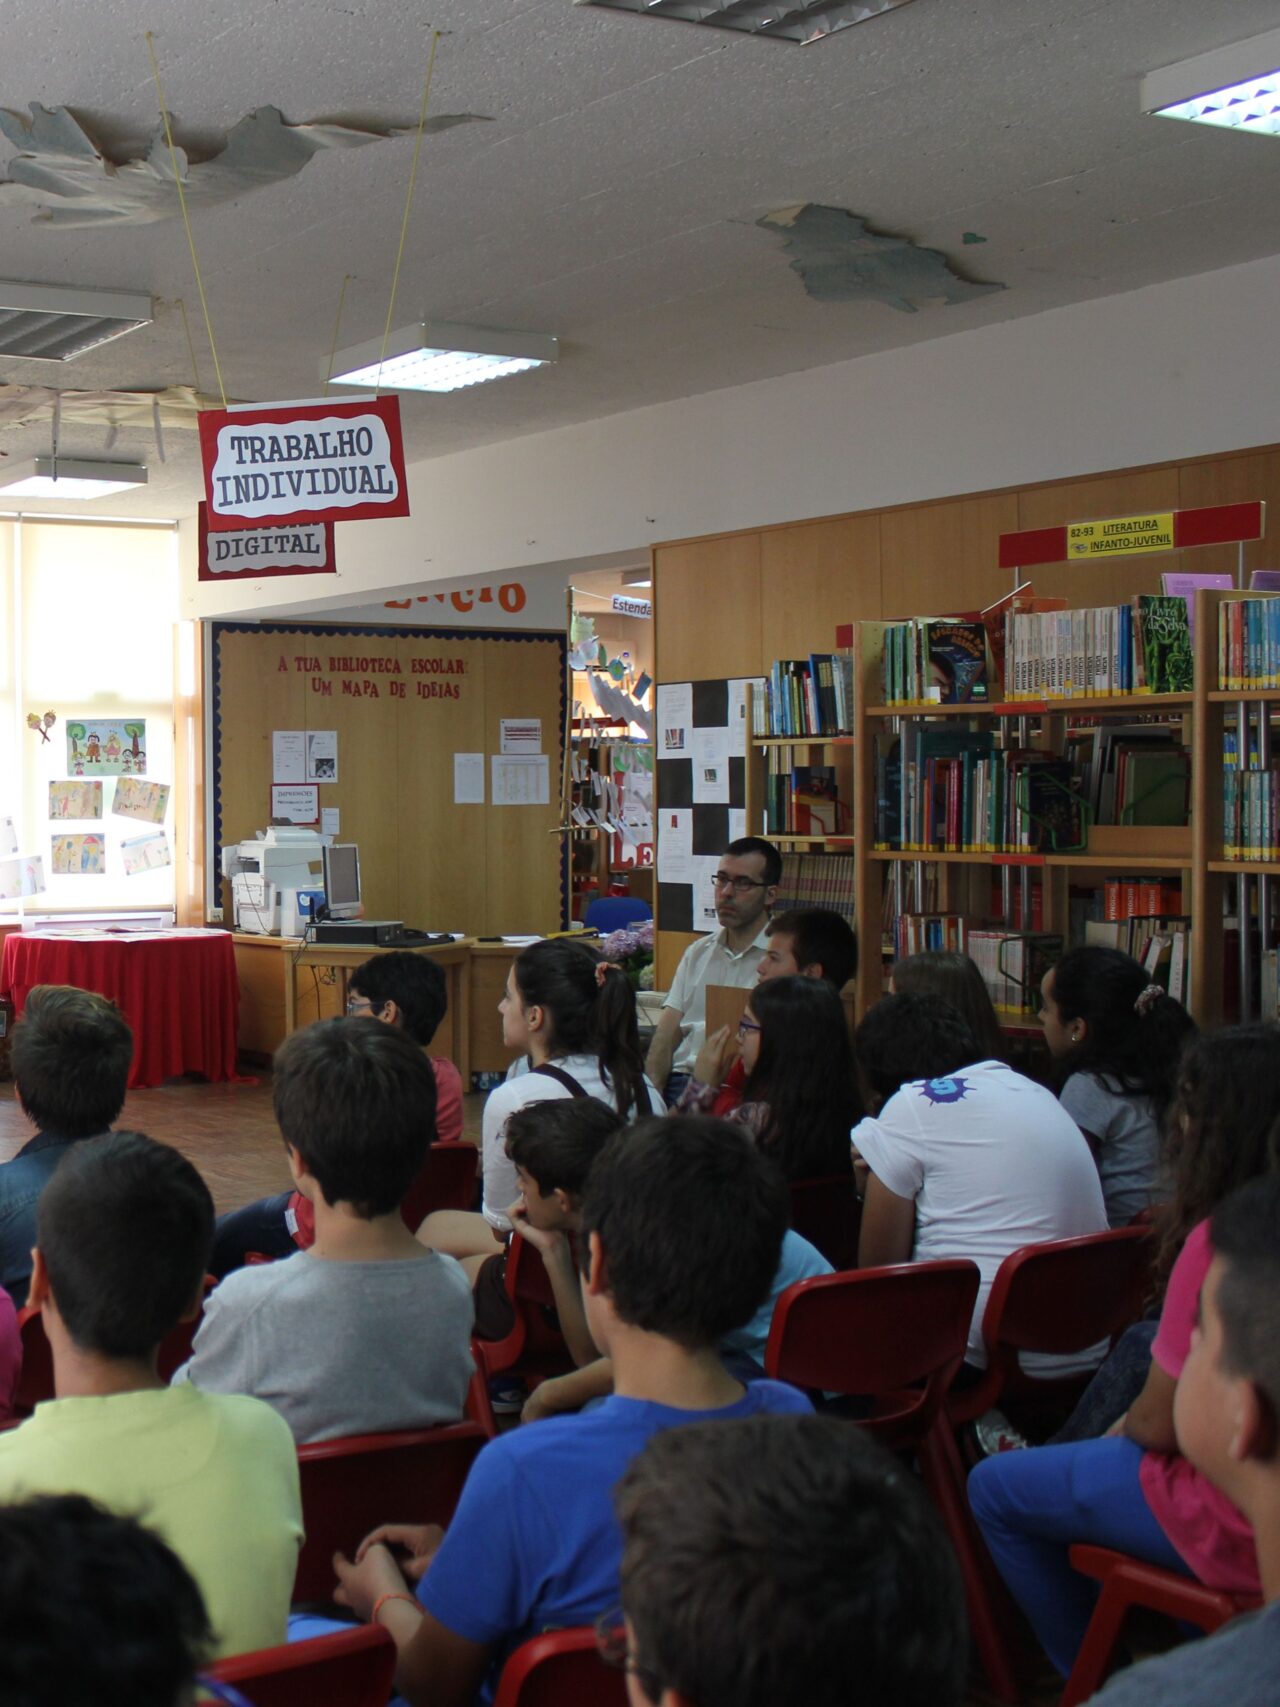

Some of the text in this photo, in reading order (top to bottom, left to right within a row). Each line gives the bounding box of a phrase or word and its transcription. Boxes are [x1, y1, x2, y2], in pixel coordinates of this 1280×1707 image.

[230, 427, 372, 464] TRABALHO
[216, 465, 394, 507] INDIVIDUAL
[1071, 520, 1159, 538] 82-93 LITERATURA
[215, 533, 320, 561] DIGITAL
[1091, 534, 1171, 551] INFANTO-JUVENIL
[278, 656, 288, 671] A
[294, 657, 322, 672] TUA
[329, 657, 402, 673] BIBLIOTECA
[312, 678, 460, 699] UM MAPA DE IDEIAS
